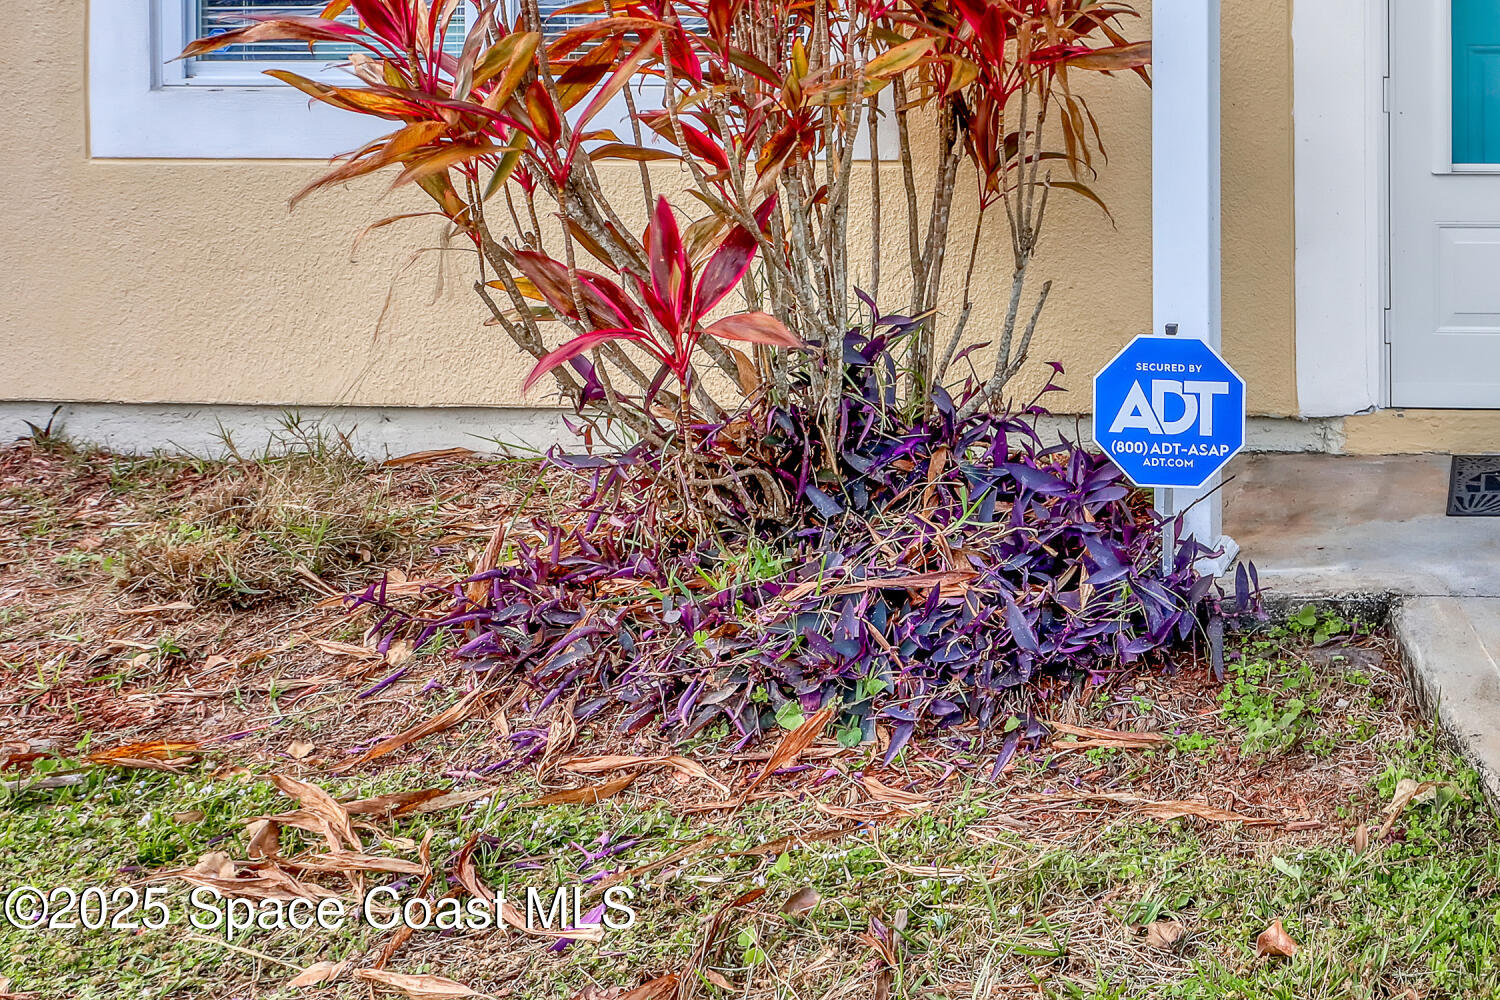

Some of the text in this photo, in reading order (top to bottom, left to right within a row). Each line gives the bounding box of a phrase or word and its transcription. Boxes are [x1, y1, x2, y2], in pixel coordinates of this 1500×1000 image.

[1136, 362, 1202, 373] SECURED BY
[1108, 379, 1229, 437] ADT
[1111, 440, 1230, 457] (800) ADT-ASAP
[1143, 458, 1194, 468] ADT.COM
